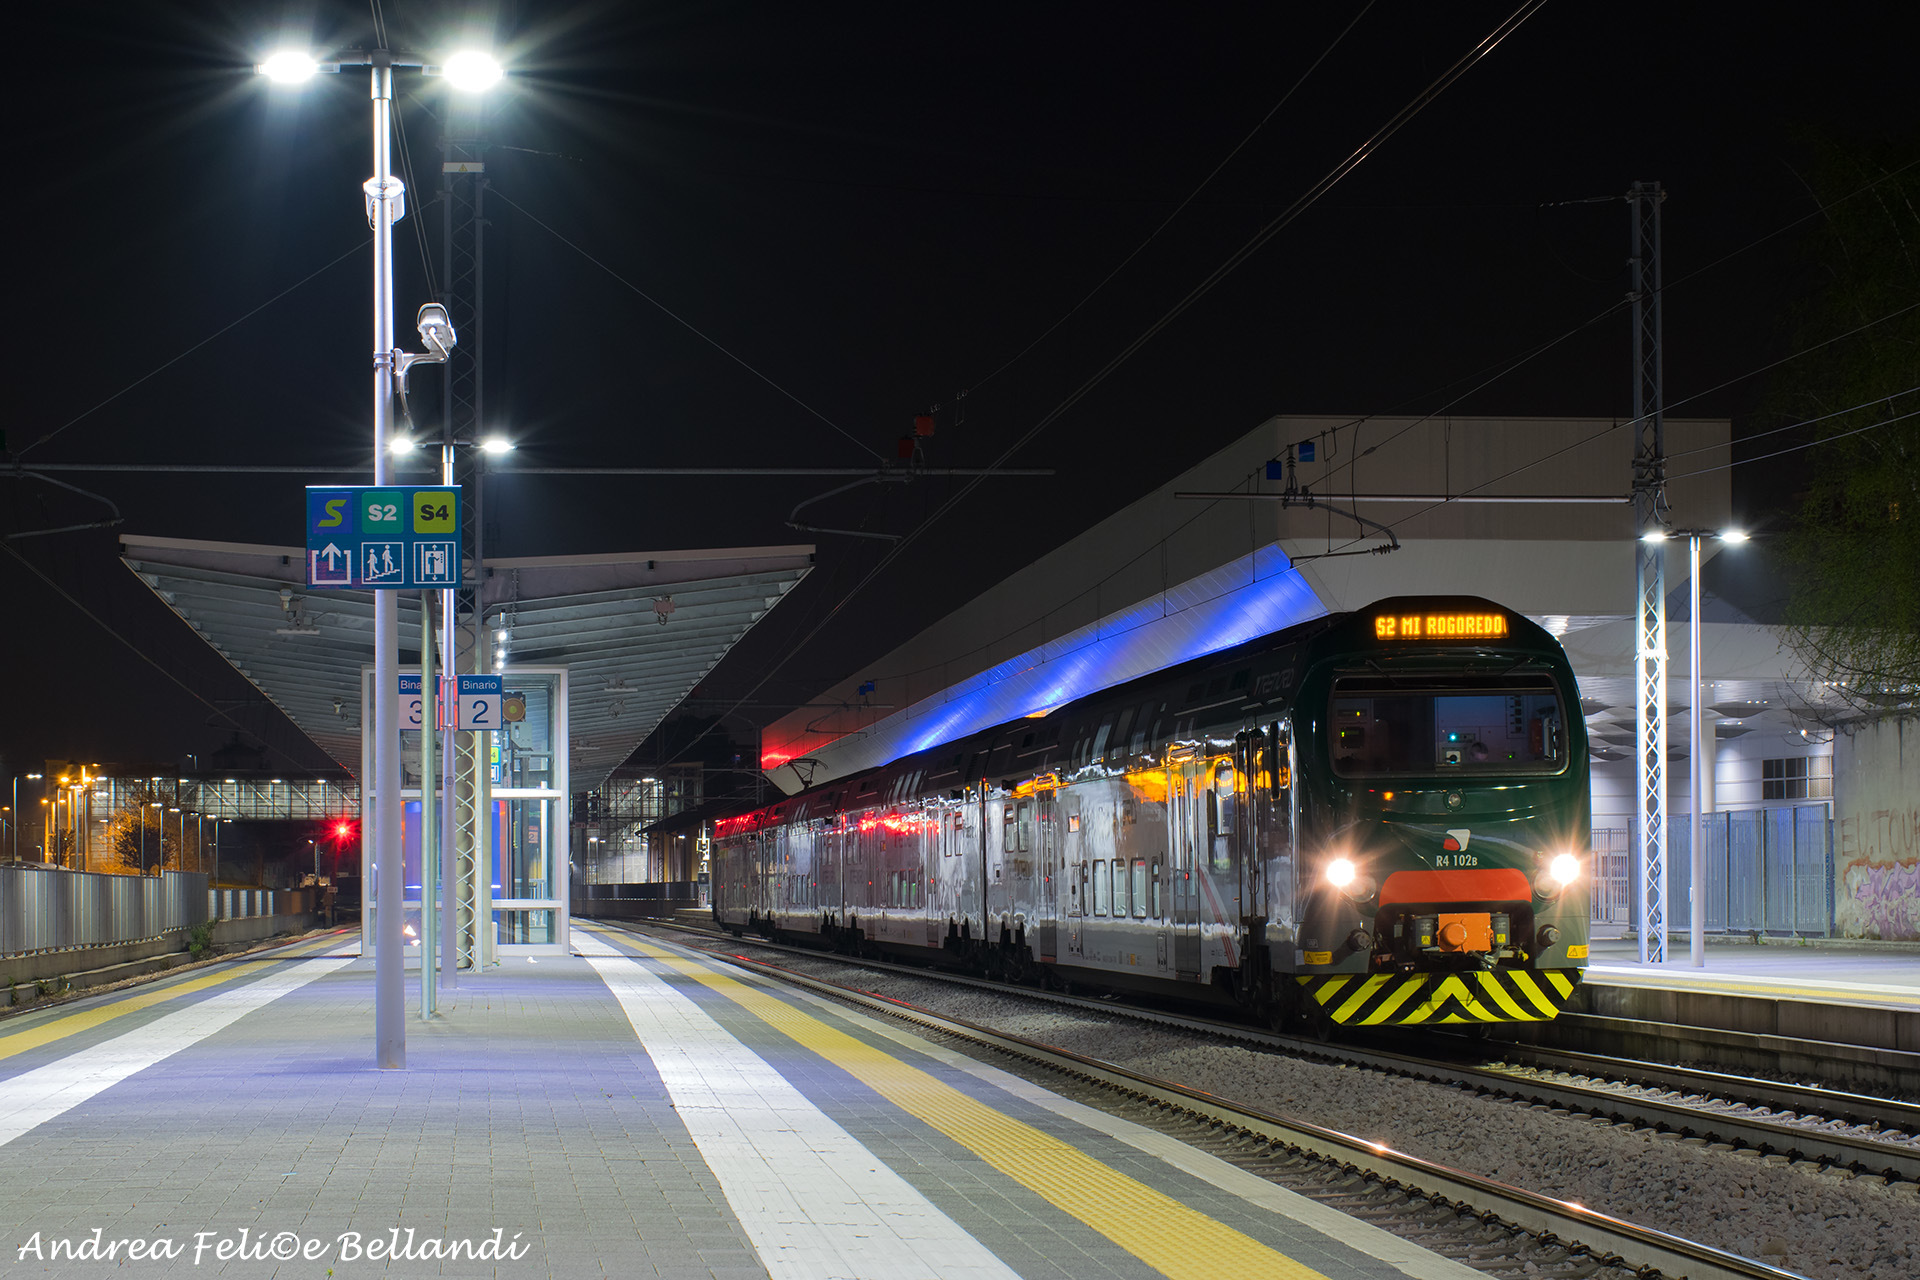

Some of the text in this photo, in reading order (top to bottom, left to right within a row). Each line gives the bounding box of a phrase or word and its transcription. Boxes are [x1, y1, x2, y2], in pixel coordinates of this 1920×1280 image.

[368, 504, 397, 521] S2
[420, 504, 449, 521] S4
[1377, 616, 1502, 635] S2 MI ROGOREDO
[400, 680, 422, 690] Bina
[462, 680, 498, 690] Binario
[409, 700, 422, 724] 3
[472, 700, 489, 724] 2
[1436, 855, 1449, 867] R4
